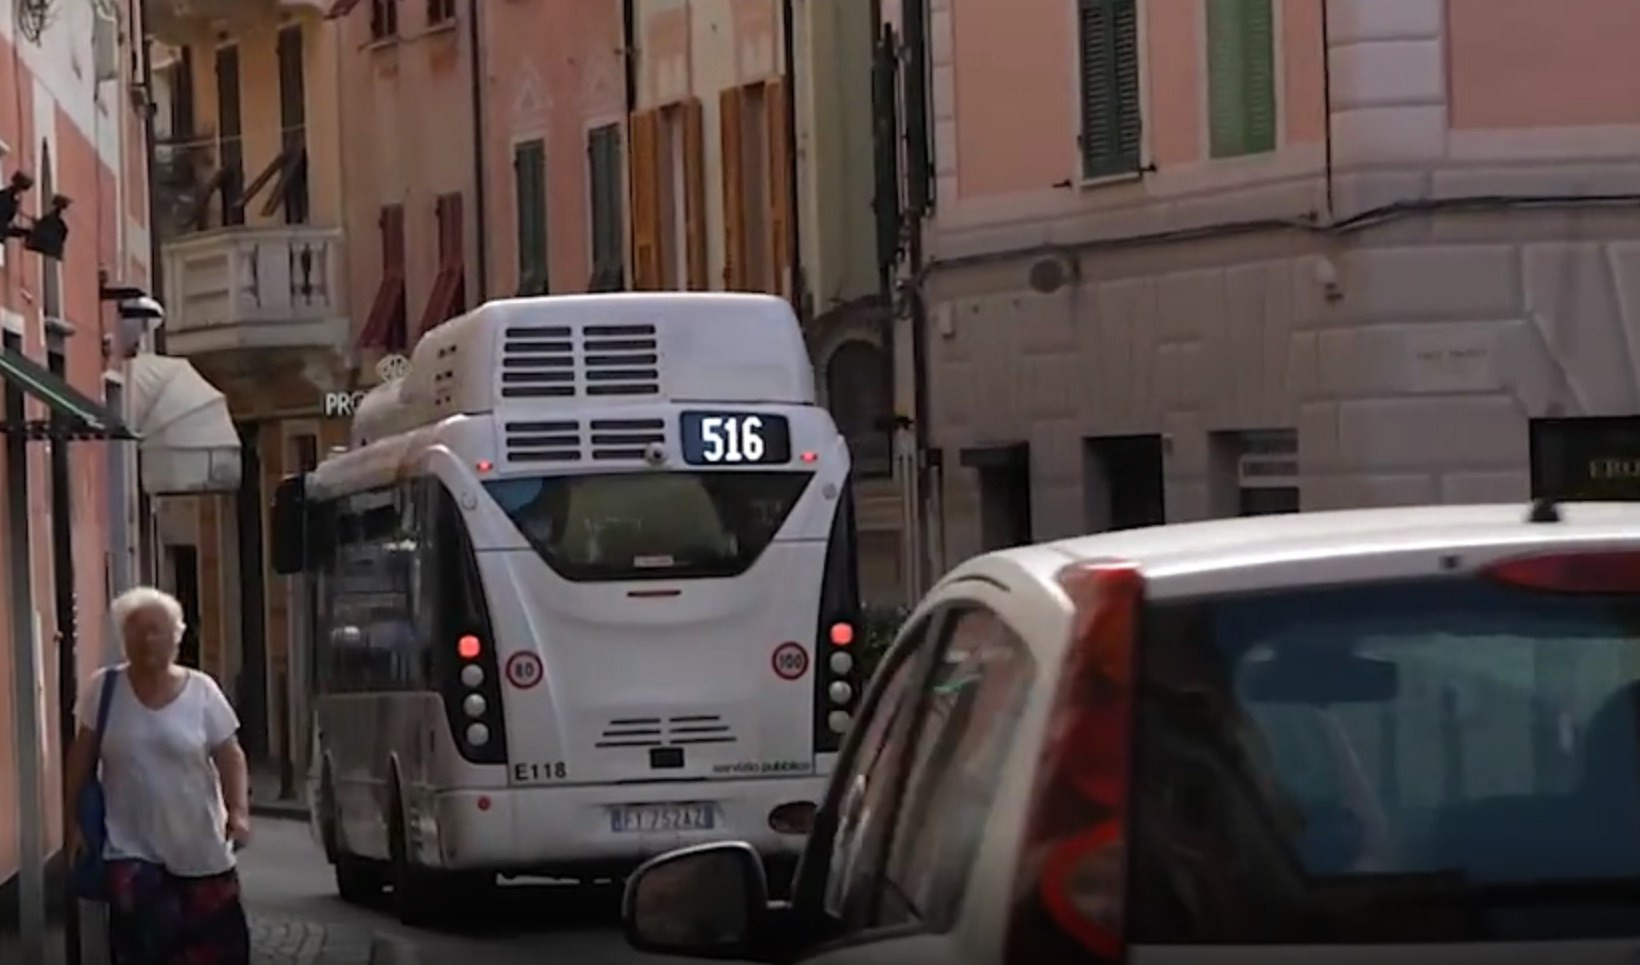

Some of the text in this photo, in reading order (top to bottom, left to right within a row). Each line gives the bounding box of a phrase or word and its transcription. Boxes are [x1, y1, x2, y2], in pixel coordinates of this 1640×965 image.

[702, 416, 764, 462] 516
[779, 653, 802, 669] 100
[514, 761, 567, 780] E118
